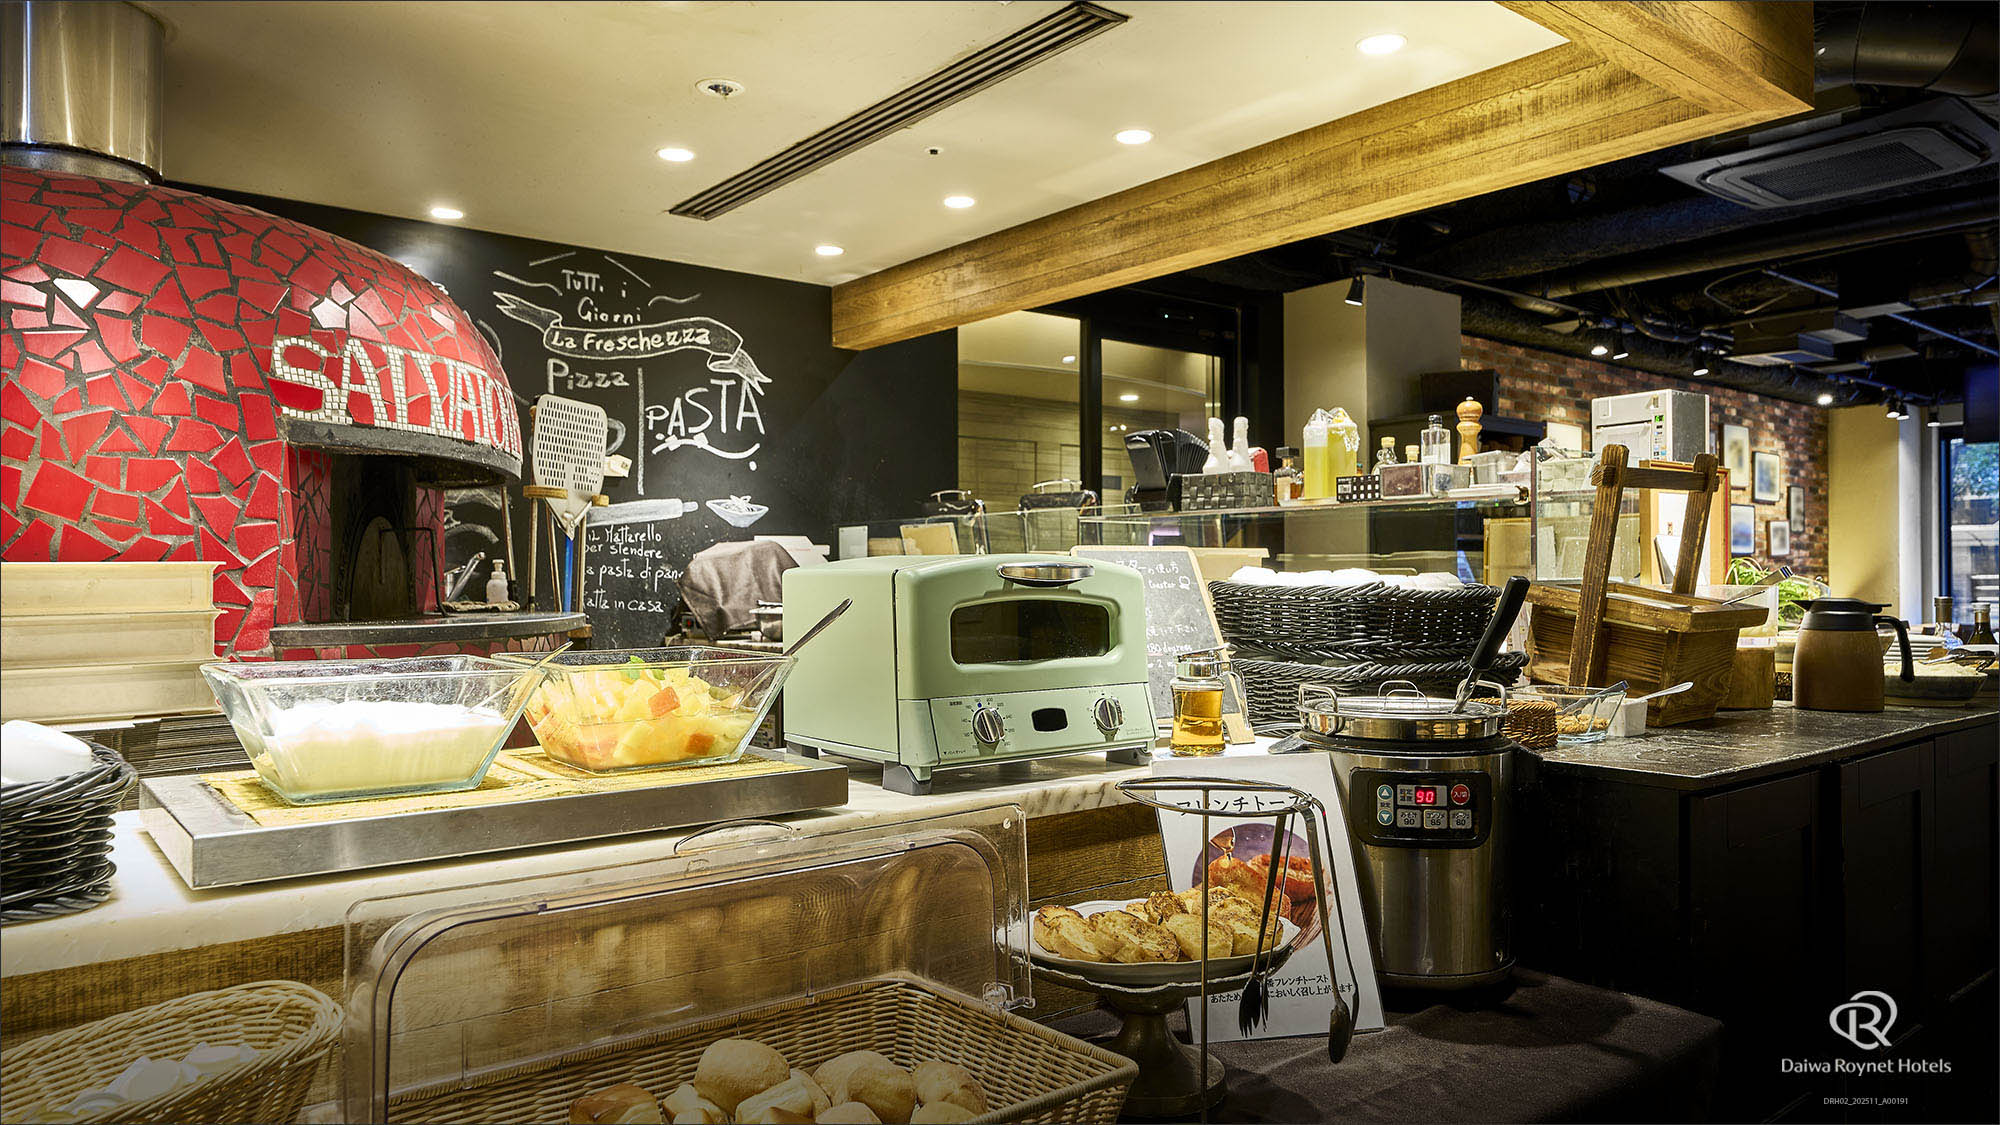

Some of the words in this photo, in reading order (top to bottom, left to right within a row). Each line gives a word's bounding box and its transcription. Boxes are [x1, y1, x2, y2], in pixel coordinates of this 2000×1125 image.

[577, 296, 641, 325] Giorni
[552, 331, 577, 349] La
[583, 328, 711, 352] Freschezza
[546, 358, 630, 395] Pizza
[645, 378, 766, 435] PASTA
[605, 523, 662, 543] Mattarello
[610, 542, 663, 559] stendere
[599, 558, 635, 586] pasta
[640, 557, 652, 579] di
[584, 588, 610, 610] atta
[614, 600, 625, 610] in
[1416, 790, 1434, 803] 90
